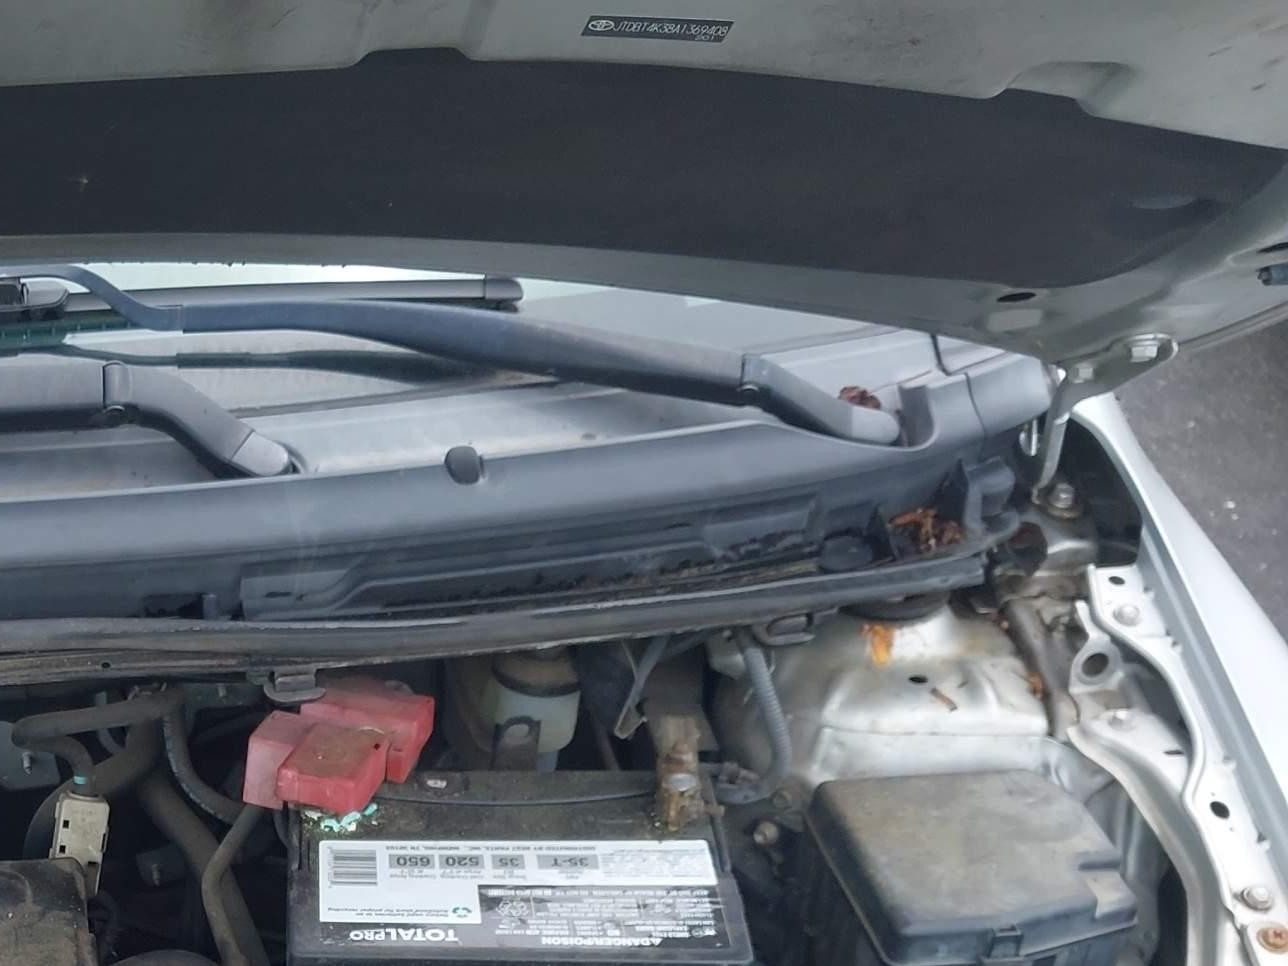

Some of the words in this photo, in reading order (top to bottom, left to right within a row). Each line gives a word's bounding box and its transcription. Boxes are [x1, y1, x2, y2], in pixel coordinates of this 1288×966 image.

[396, 856, 430, 867] 650
[445, 856, 480, 867] 520
[498, 857, 520, 867] 35
[551, 857, 589, 868] 35-T
